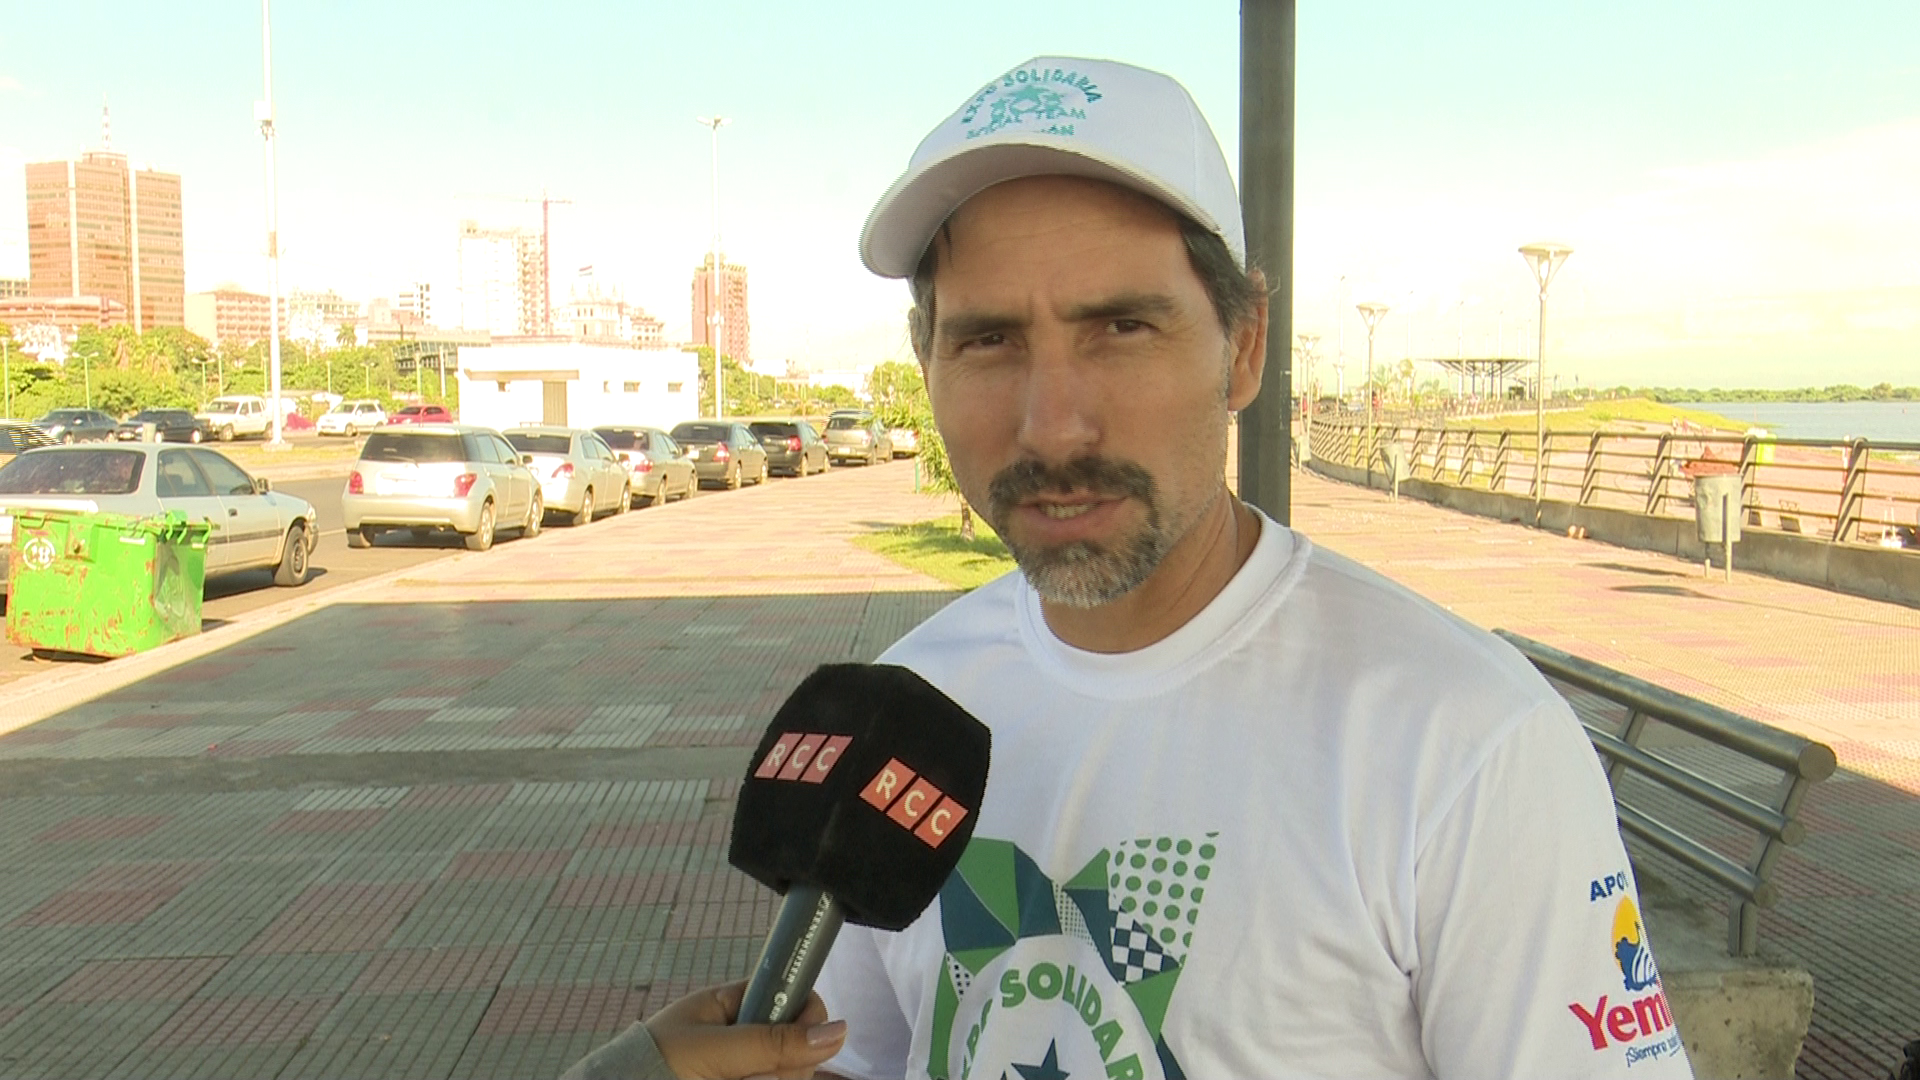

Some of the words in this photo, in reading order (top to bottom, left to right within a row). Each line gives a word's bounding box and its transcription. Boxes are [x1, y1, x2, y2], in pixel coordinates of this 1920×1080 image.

[1004, 68, 1103, 103] SOLIDARIA
[766, 742, 837, 772] RCC
[875, 768, 951, 836] RCC
